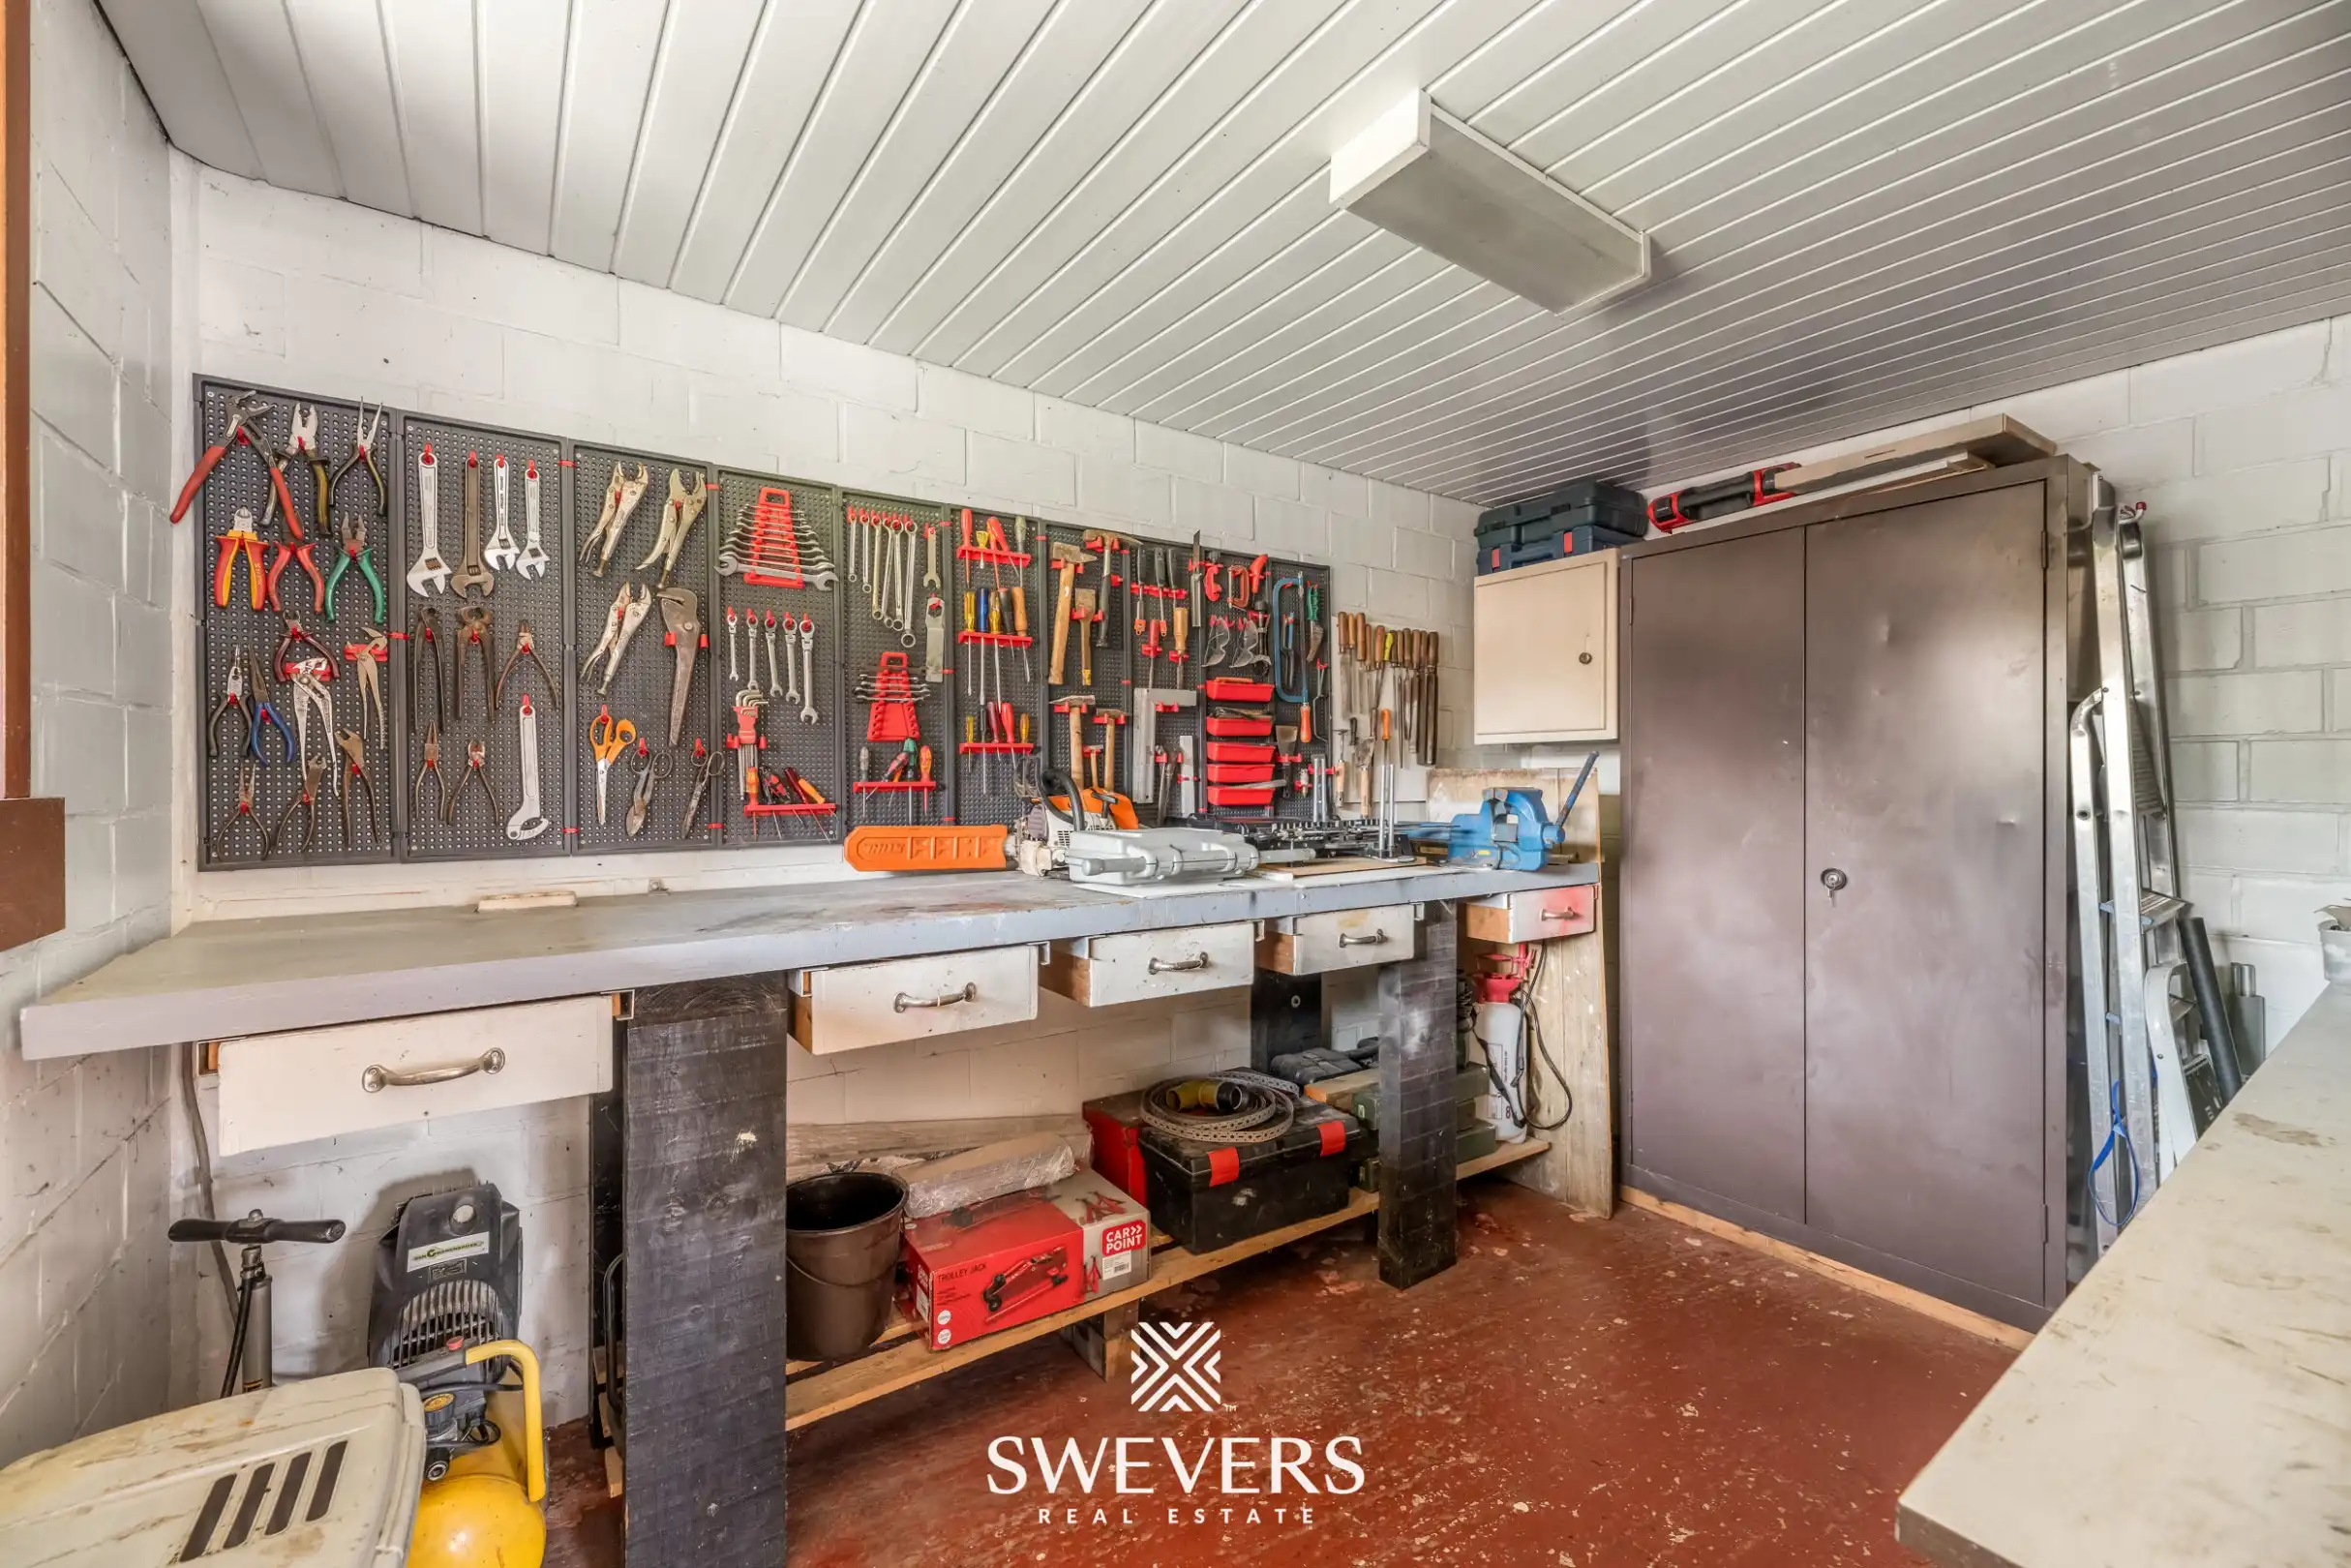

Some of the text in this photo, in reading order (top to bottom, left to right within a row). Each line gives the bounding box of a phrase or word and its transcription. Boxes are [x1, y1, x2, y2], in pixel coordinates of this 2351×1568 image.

[1106, 1227, 1130, 1243] CAR
[1106, 1234, 1143, 1254] POINT
[937, 1267, 968, 1282] TROLLEY
[970, 1262, 987, 1275] JACK
